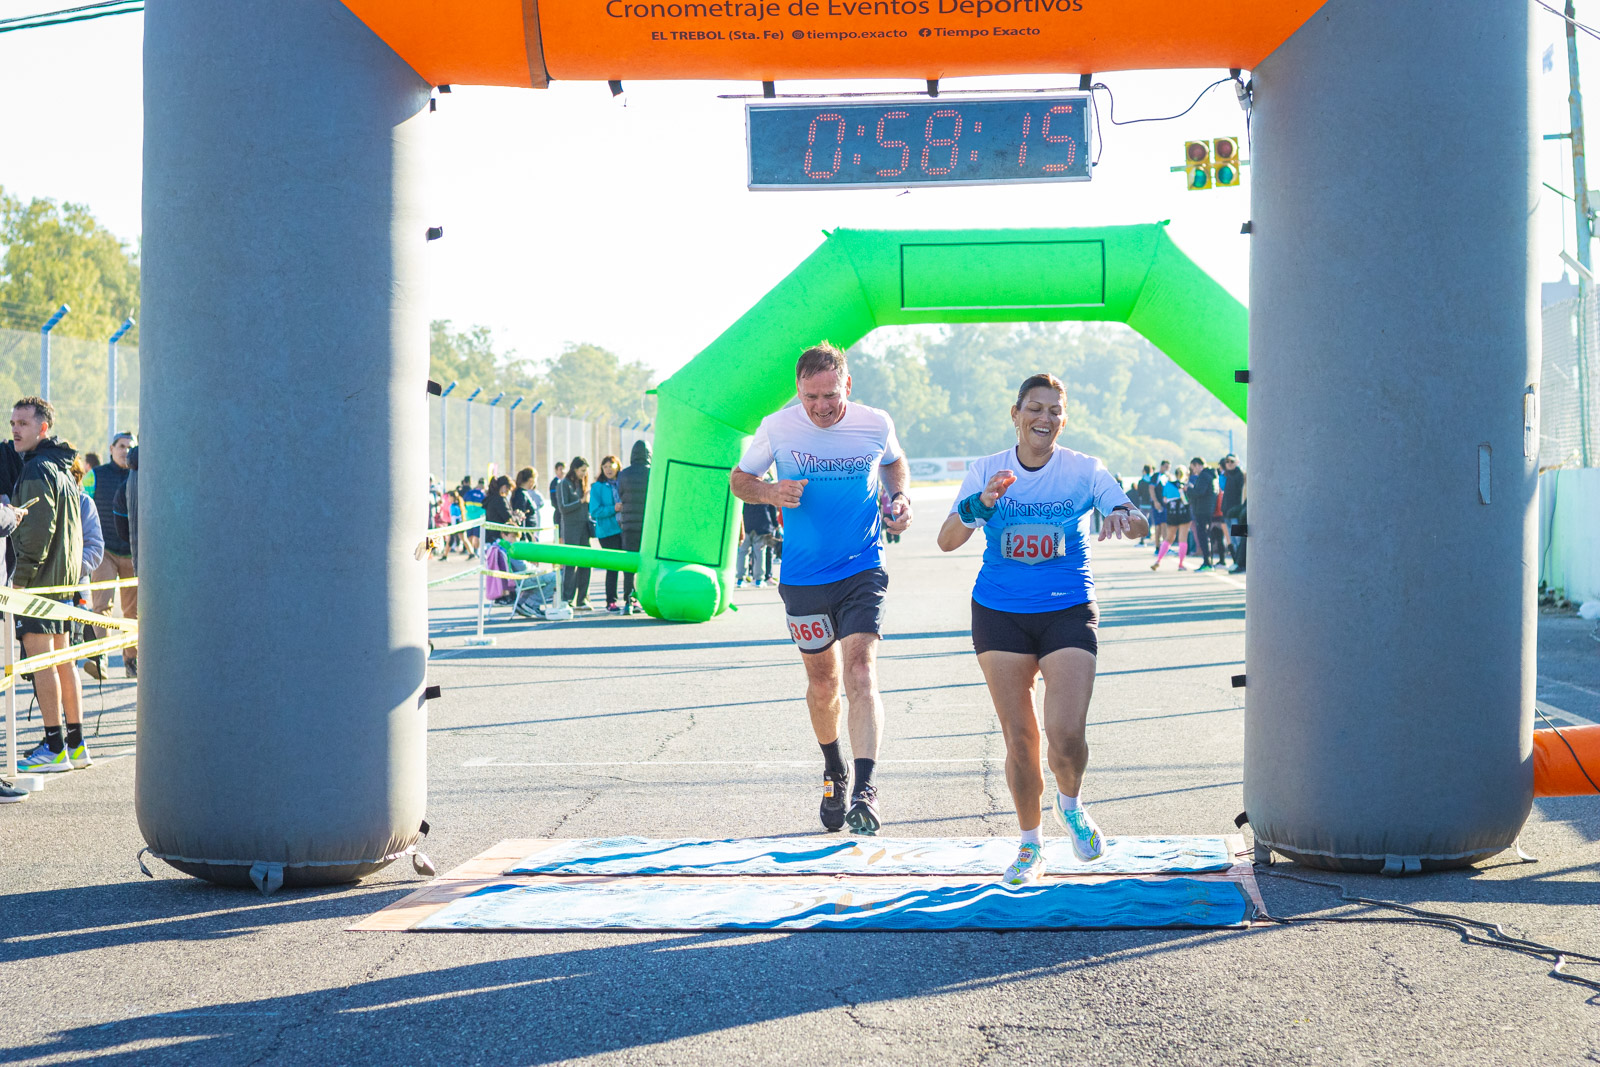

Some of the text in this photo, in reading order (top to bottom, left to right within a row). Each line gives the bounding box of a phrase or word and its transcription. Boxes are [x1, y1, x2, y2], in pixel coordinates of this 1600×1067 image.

[606, 0, 1083, 21] Cronometraje de Eventos Deportivos
[651, 30, 784, 41] EL TREBOL (Sta. Fe)
[807, 29, 908, 40] tiempo.exacto
[934, 26, 1040, 39] Tiempo Exacto
[803, 105, 1076, 179] 0:58:15
[1012, 534, 1053, 558] 250
[790, 621, 824, 641] 366
